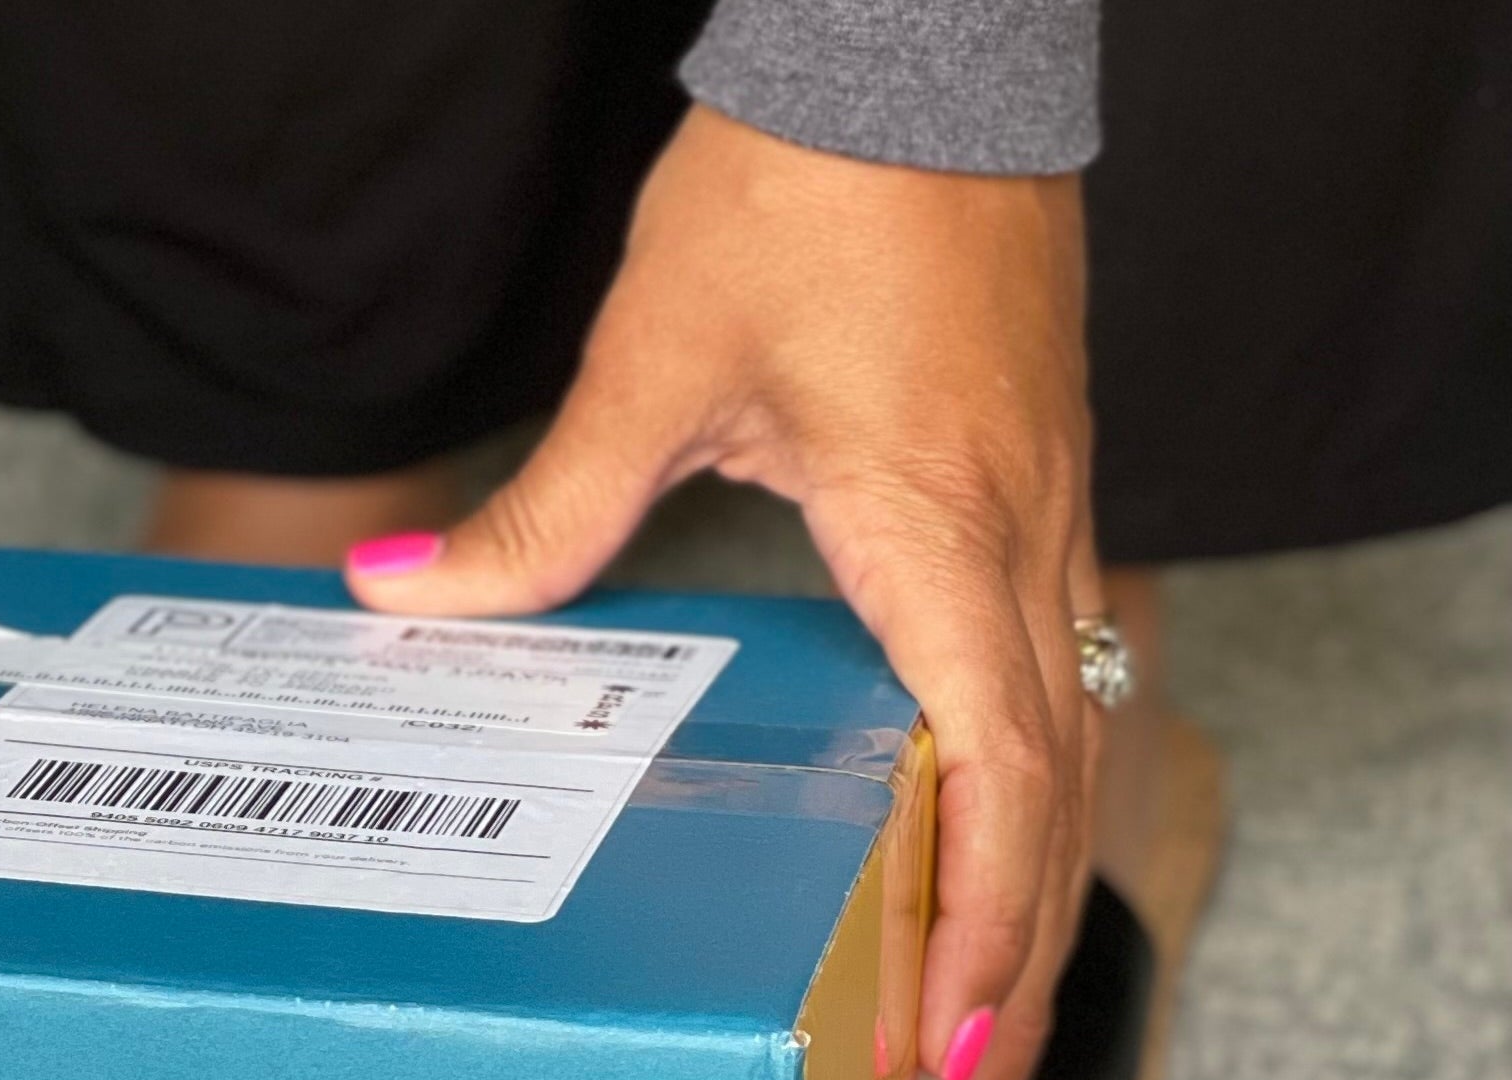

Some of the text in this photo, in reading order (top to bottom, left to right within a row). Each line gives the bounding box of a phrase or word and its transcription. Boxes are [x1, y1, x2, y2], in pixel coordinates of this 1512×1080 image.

[184, 760, 243, 770] USPS
[253, 766, 363, 781] TRACKING
[83, 825, 148, 837] Shipping
[91, 811, 139, 821] 9405
[254, 826, 303, 836] 4717
[310, 831, 359, 840] 9037
[364, 835, 390, 843] 10
[5, 827, 54, 836] offsets
[59, 830, 97, 840] 100%
[145, 838, 197, 847] carbon
[199, 842, 271, 853] emissions
[274, 849, 310, 857] from
[314, 852, 347, 861] your
